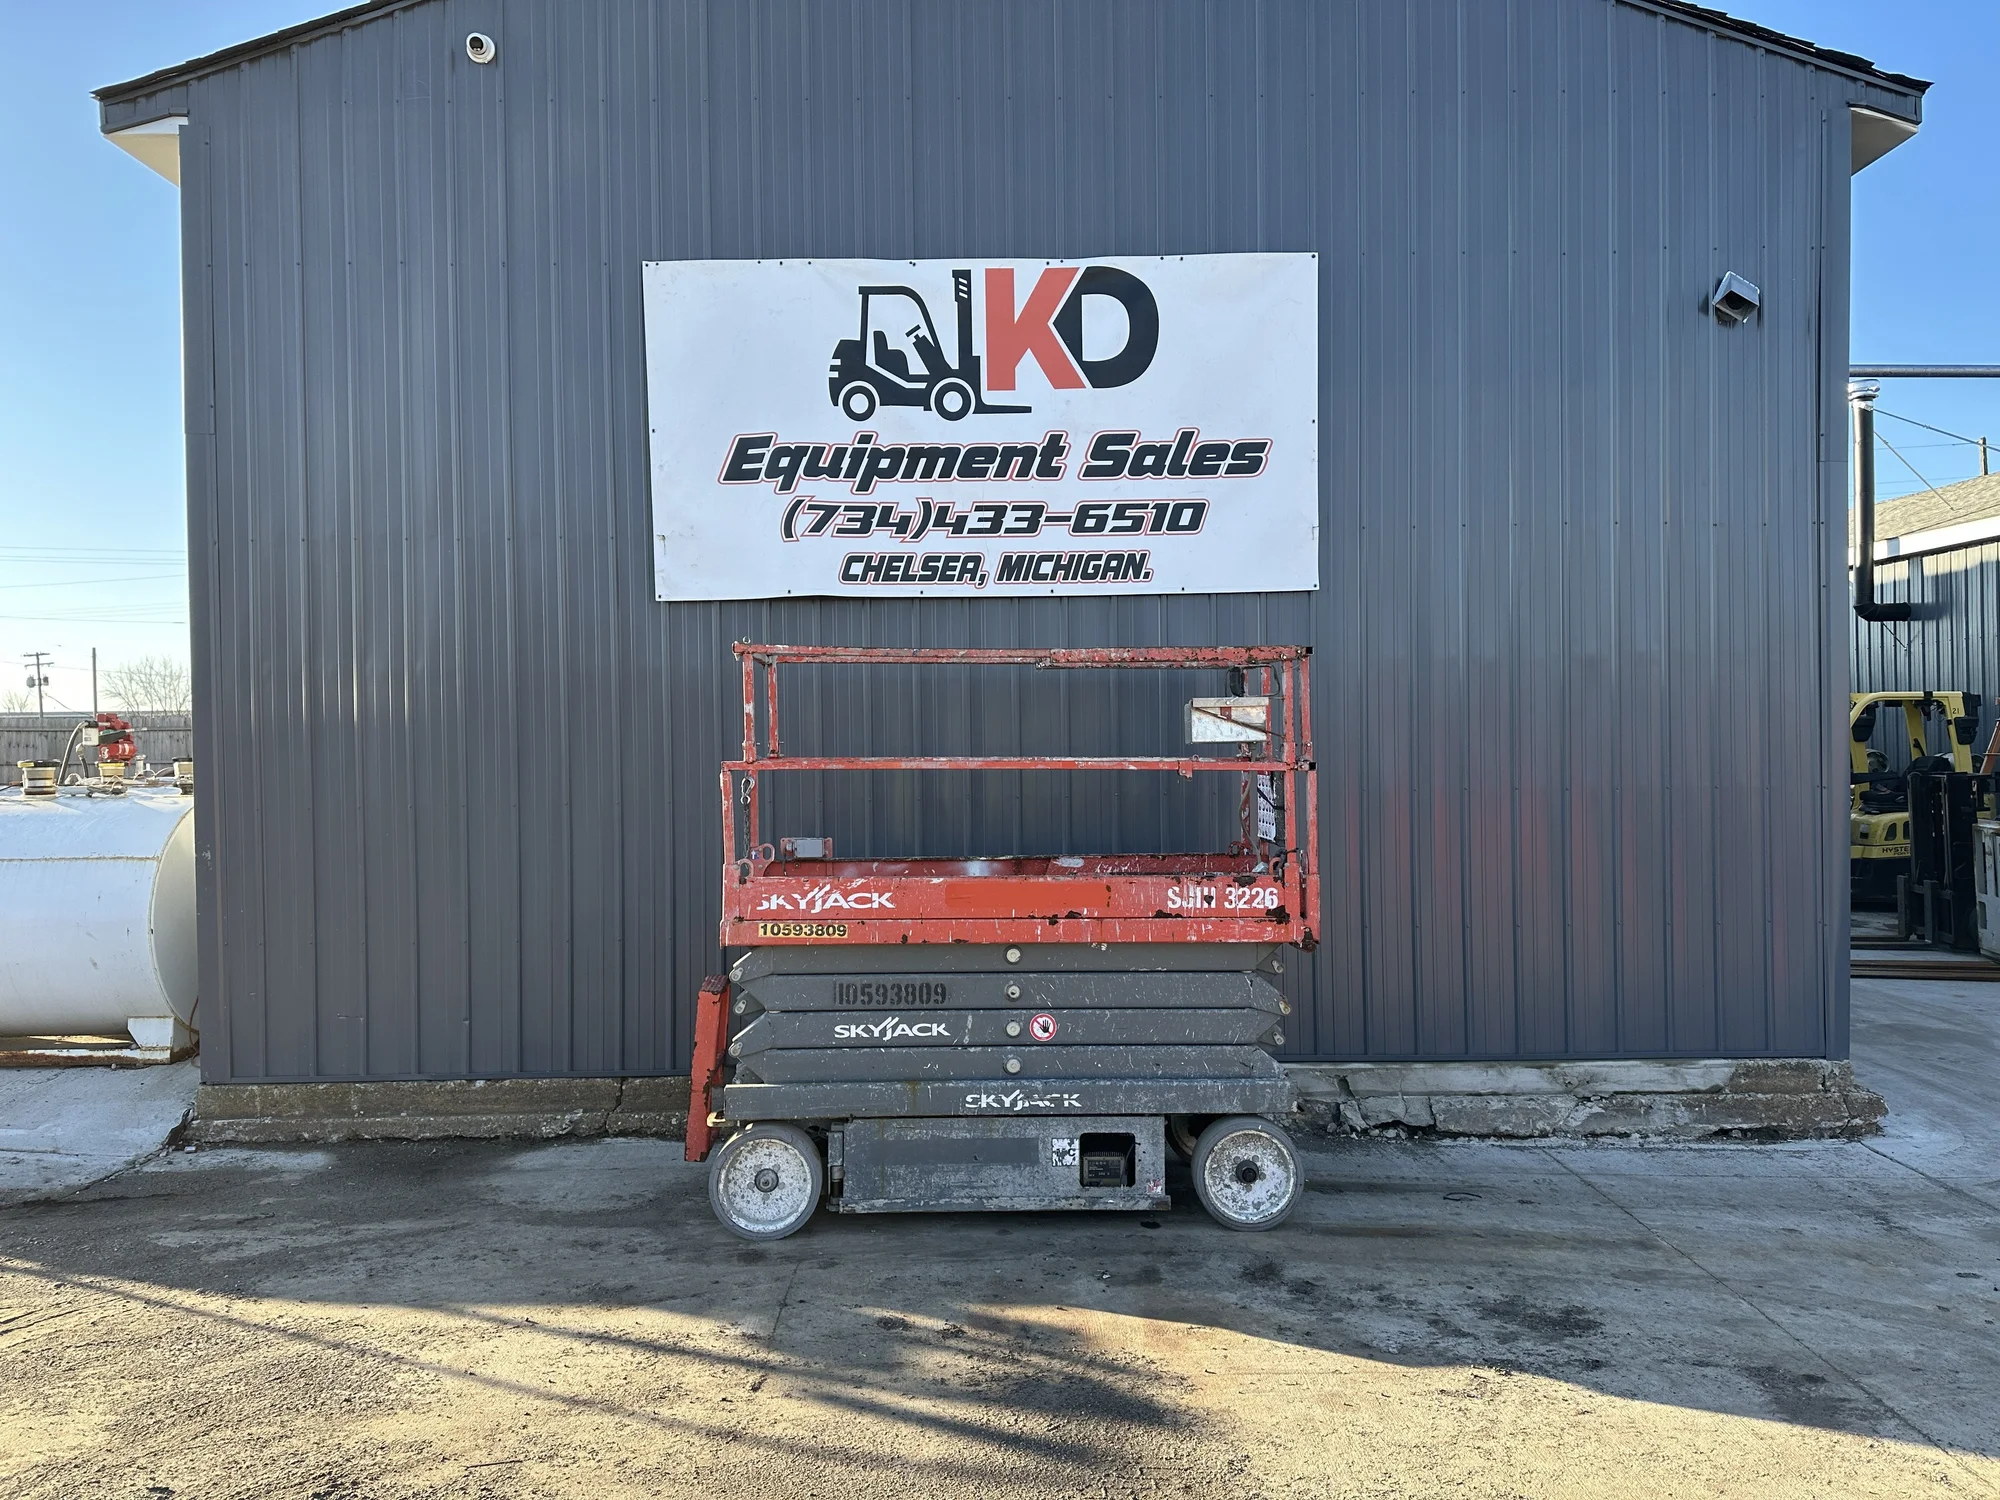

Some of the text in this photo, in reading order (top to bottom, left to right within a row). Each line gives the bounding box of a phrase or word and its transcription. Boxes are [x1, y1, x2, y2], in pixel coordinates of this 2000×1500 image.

[984, 265, 1159, 392] KD
[718, 427, 1273, 495] Equipment Sales
[780, 497, 1210, 543] (734)433-6510
[839, 550, 1153, 588] CHELSEA, MICHIGAN.
[1952, 707, 1960, 715] 21
[756, 883, 896, 914] SKYJACK
[1223, 886, 1278, 909] 3226
[760, 923, 847, 937] 10593809
[837, 982, 947, 1006] 10593809
[834, 1016, 951, 1041] SKYJACK
